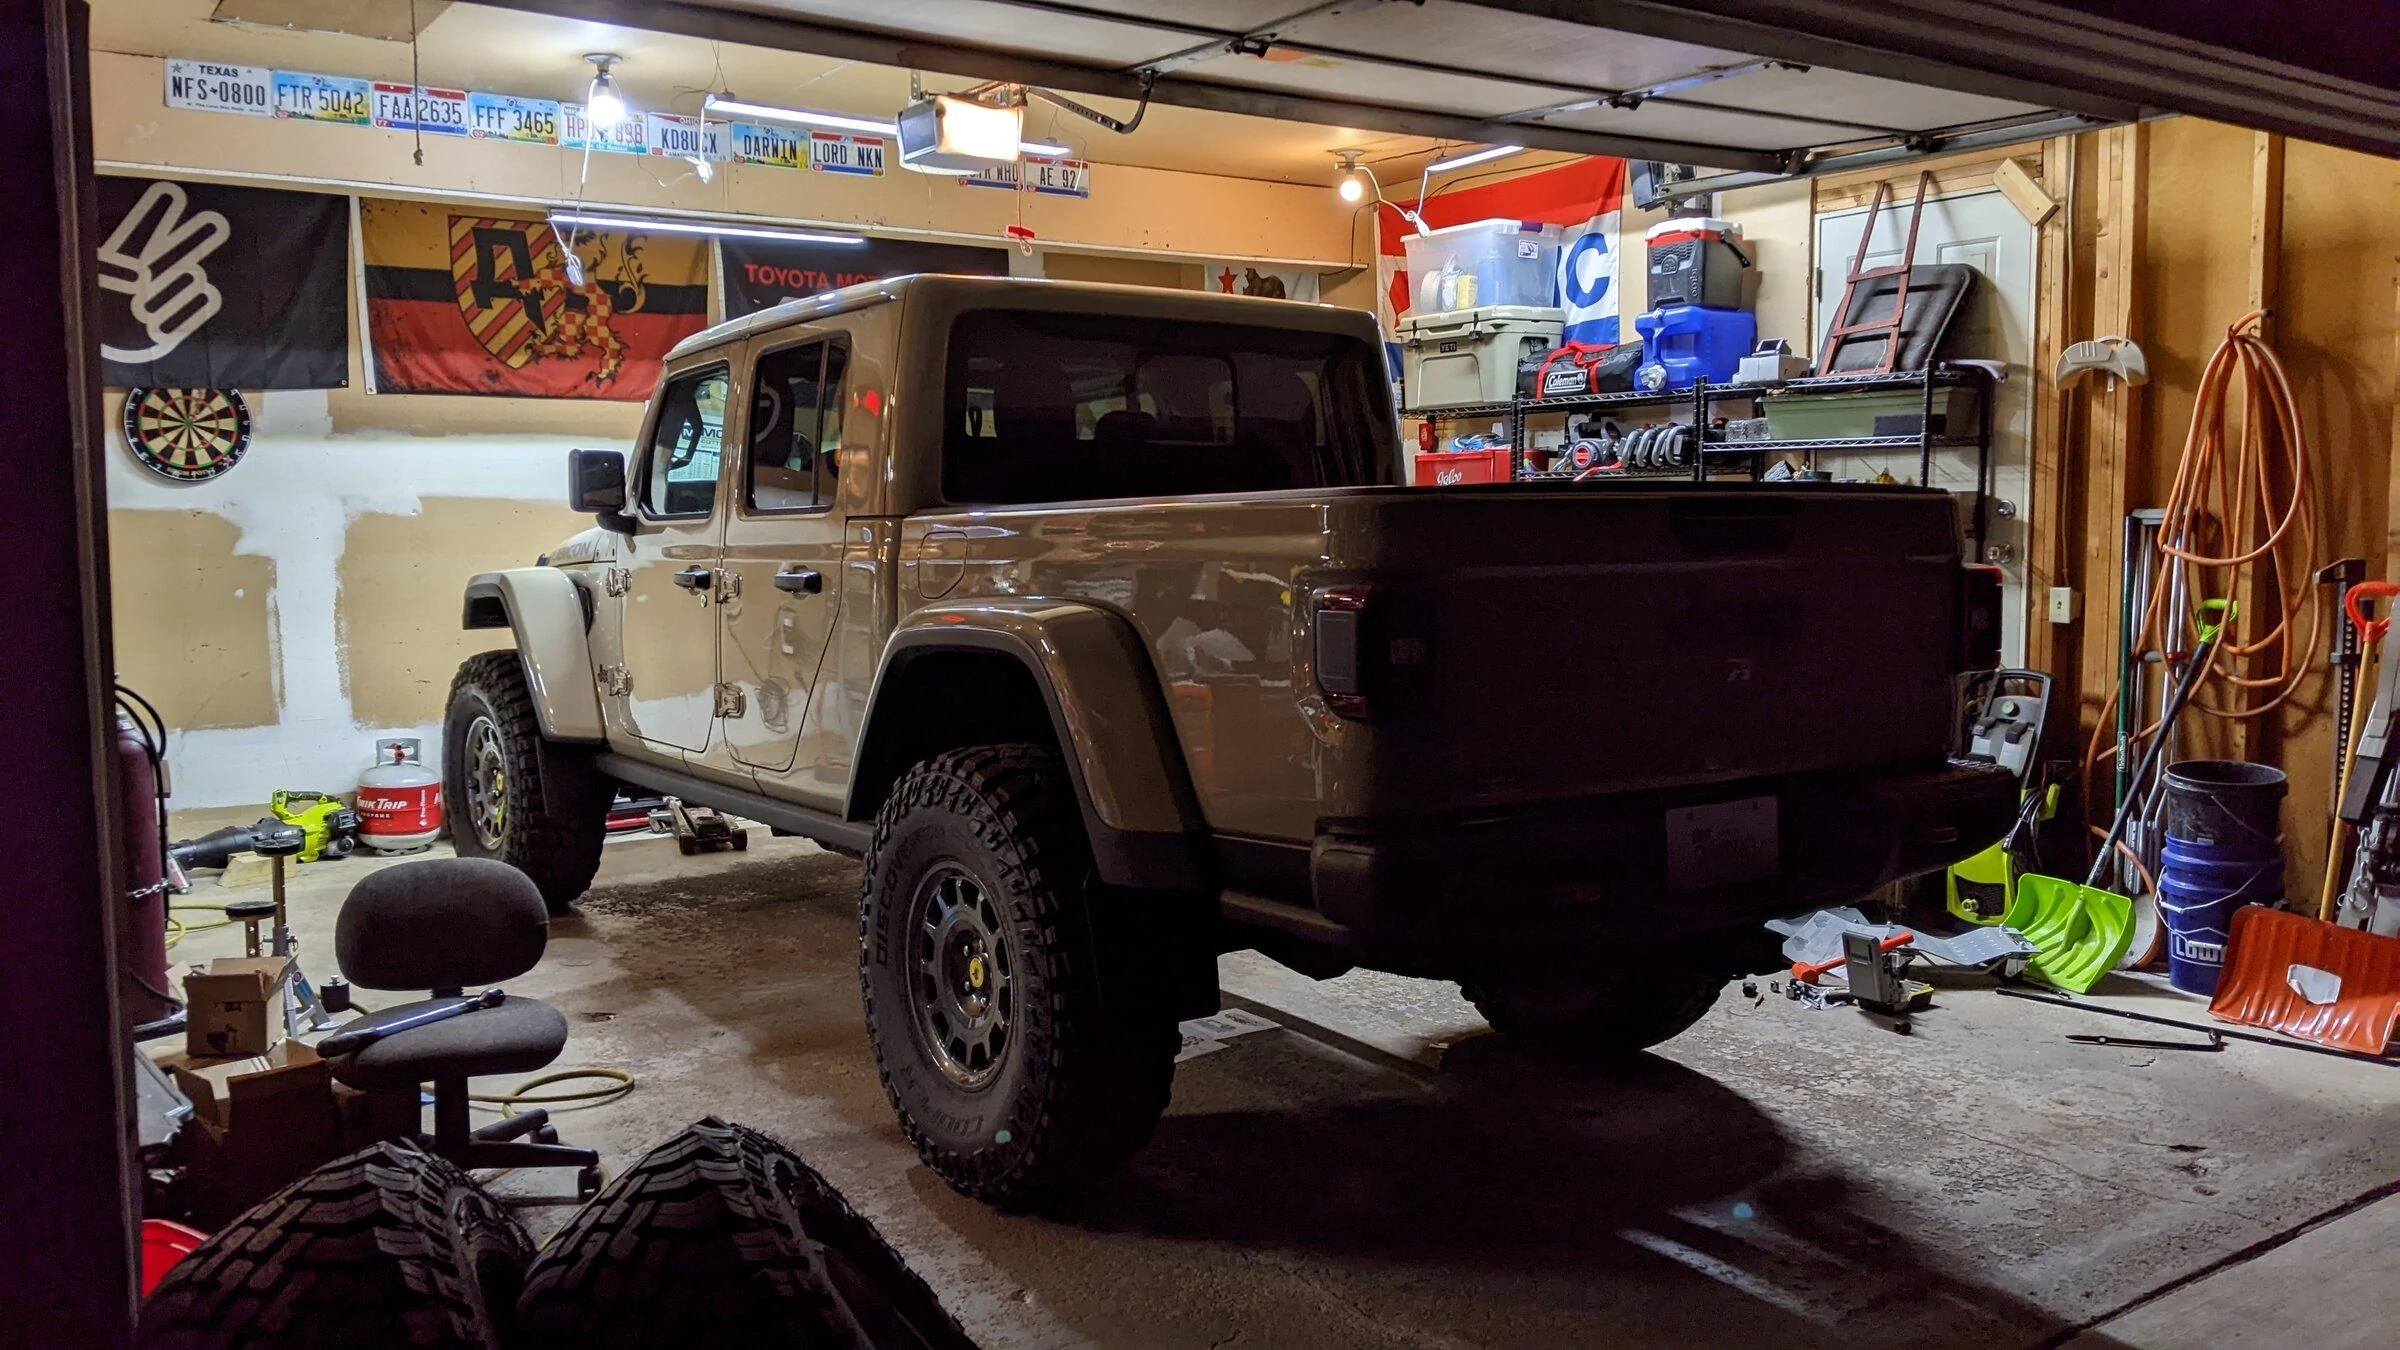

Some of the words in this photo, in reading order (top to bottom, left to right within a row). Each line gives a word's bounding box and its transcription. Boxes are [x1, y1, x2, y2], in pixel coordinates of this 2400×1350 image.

[198, 64, 239, 77] TEXAS
[278, 84, 312, 109] FTR
[319, 88, 364, 114] 5042
[380, 94, 412, 120] FAA
[419, 98, 462, 124] 2635
[476, 105, 507, 130] FFF
[513, 109, 554, 134] 3465
[744, 134, 797, 160] DARWIN
[813, 142, 847, 165] LORD
[857, 146, 883, 169] NKN
[1040, 166, 1053, 186] AE
[1062, 169, 1076, 188] 92
[743, 263, 830, 289] TOYOTA
[835, 273, 880, 288] MO
[1440, 342, 1456, 352] YETI
[1548, 374, 1578, 388] Coleman
[376, 798, 408, 809] TRIP
